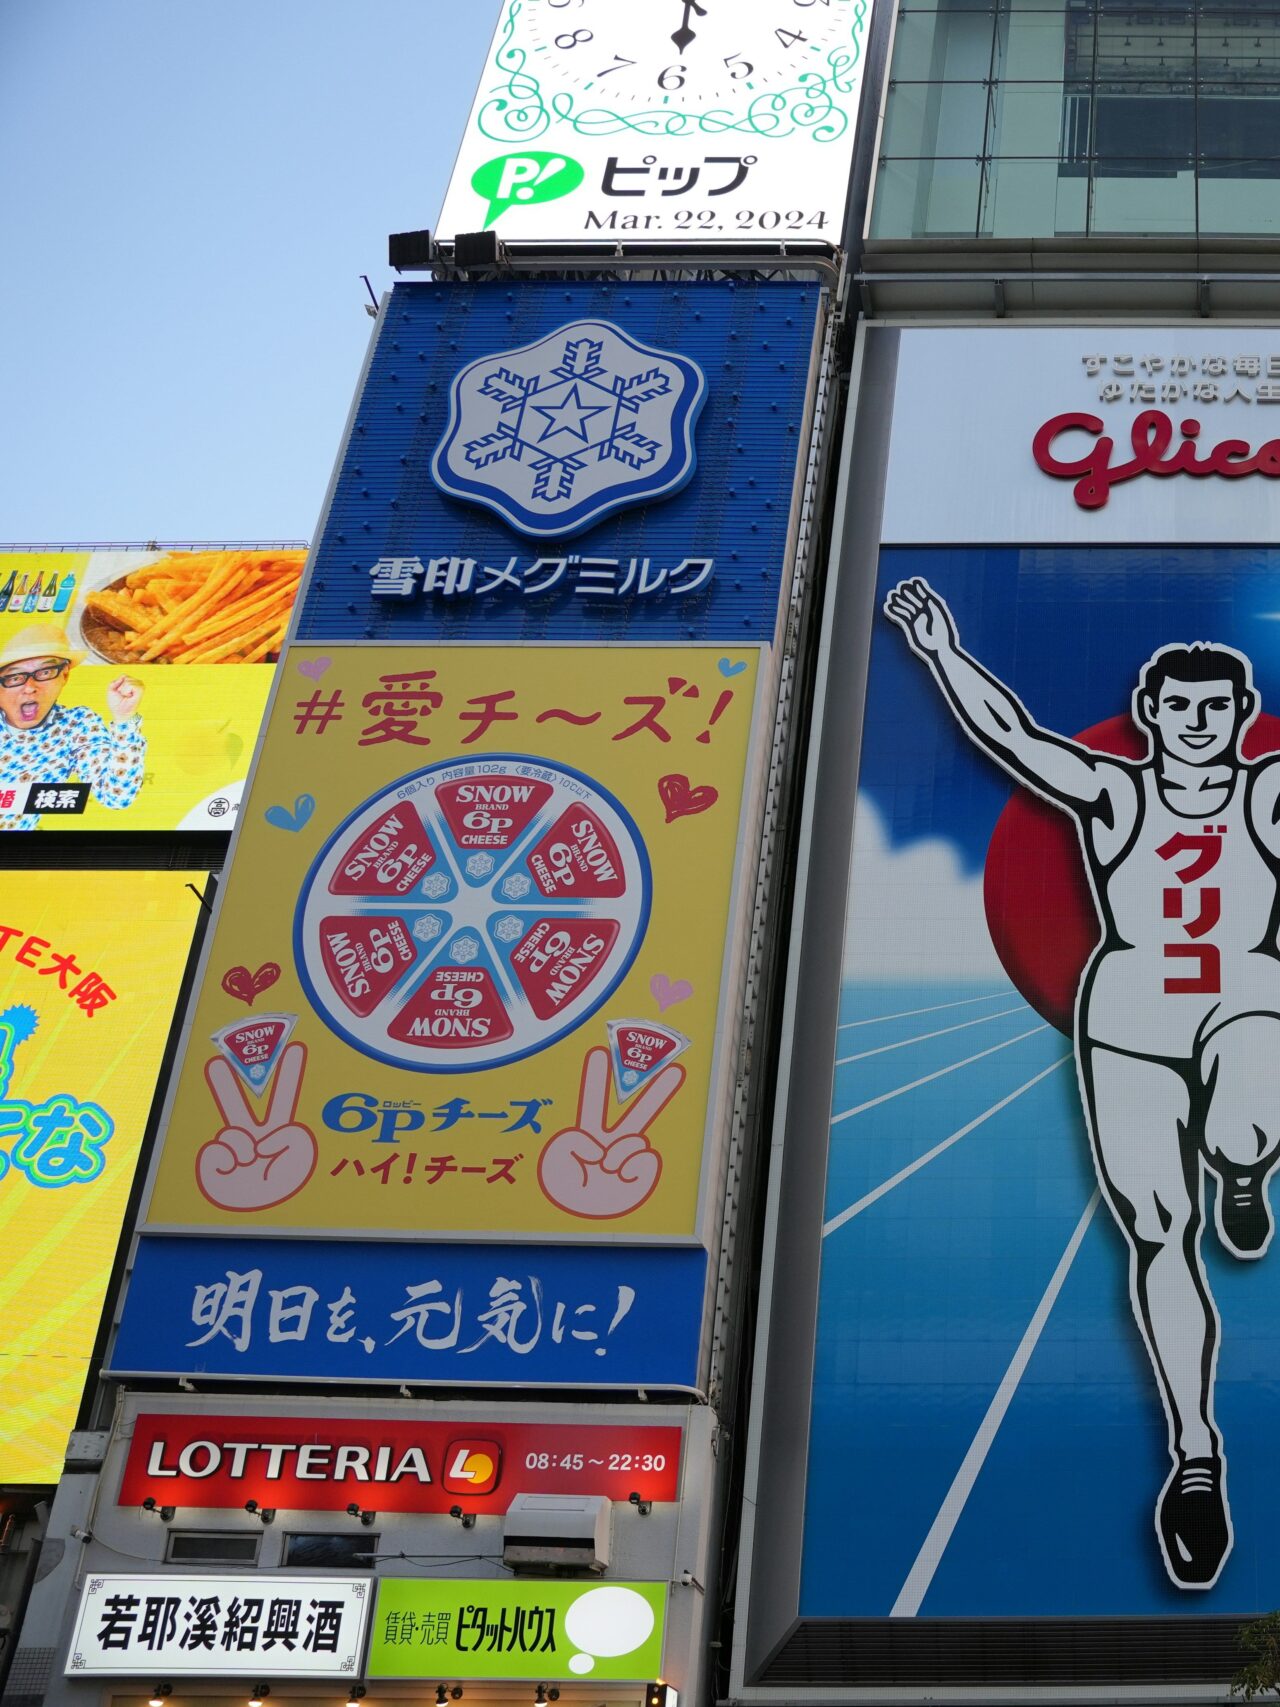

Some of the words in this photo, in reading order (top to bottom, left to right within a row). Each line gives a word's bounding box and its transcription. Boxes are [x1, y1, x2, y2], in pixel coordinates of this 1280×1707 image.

[554, 28, 594, 50] 8
[774, 28, 808, 49] 4
[596, 55, 637, 77] 7
[657, 65, 688, 90] 6
[723, 53, 754, 80] 5
[600, 154, 758, 197] ピップ
[583, 211, 662, 230] Mar.
[673, 210, 724, 232] 22,
[736, 211, 829, 230] 2024
[368, 554, 715, 596] 雪印メグミルク
[33, 790, 80, 809] 検索
[397, 776, 435, 800] 6個入り
[455, 784, 536, 803] SNOW
[344, 813, 406, 881] SNOW
[461, 834, 509, 845] CHEESE
[571, 819, 618, 883] SNOW
[395, 852, 433, 892] CHEESE
[530, 854, 557, 894] CHEESE
[1154, 825, 1228, 994] グリコ
[326, 931, 372, 998] SNOW
[545, 933, 605, 1007] SNOW
[235, 1024, 276, 1044] SNOW
[406, 1017, 492, 1038] SNOW
[626, 1031, 668, 1050] SNOW
[330, 1152, 524, 1185] ハイ!チーズ
[184, 1268, 636, 1357] 明日を、元気に!
[146, 1440, 432, 1483] LOTTERIA
[96, 1593, 345, 1654] 若耶溪紹興酒
[383, 1610, 452, 1646] 賃貸・売買
[454, 1604, 557, 1653] ピタットハウス
